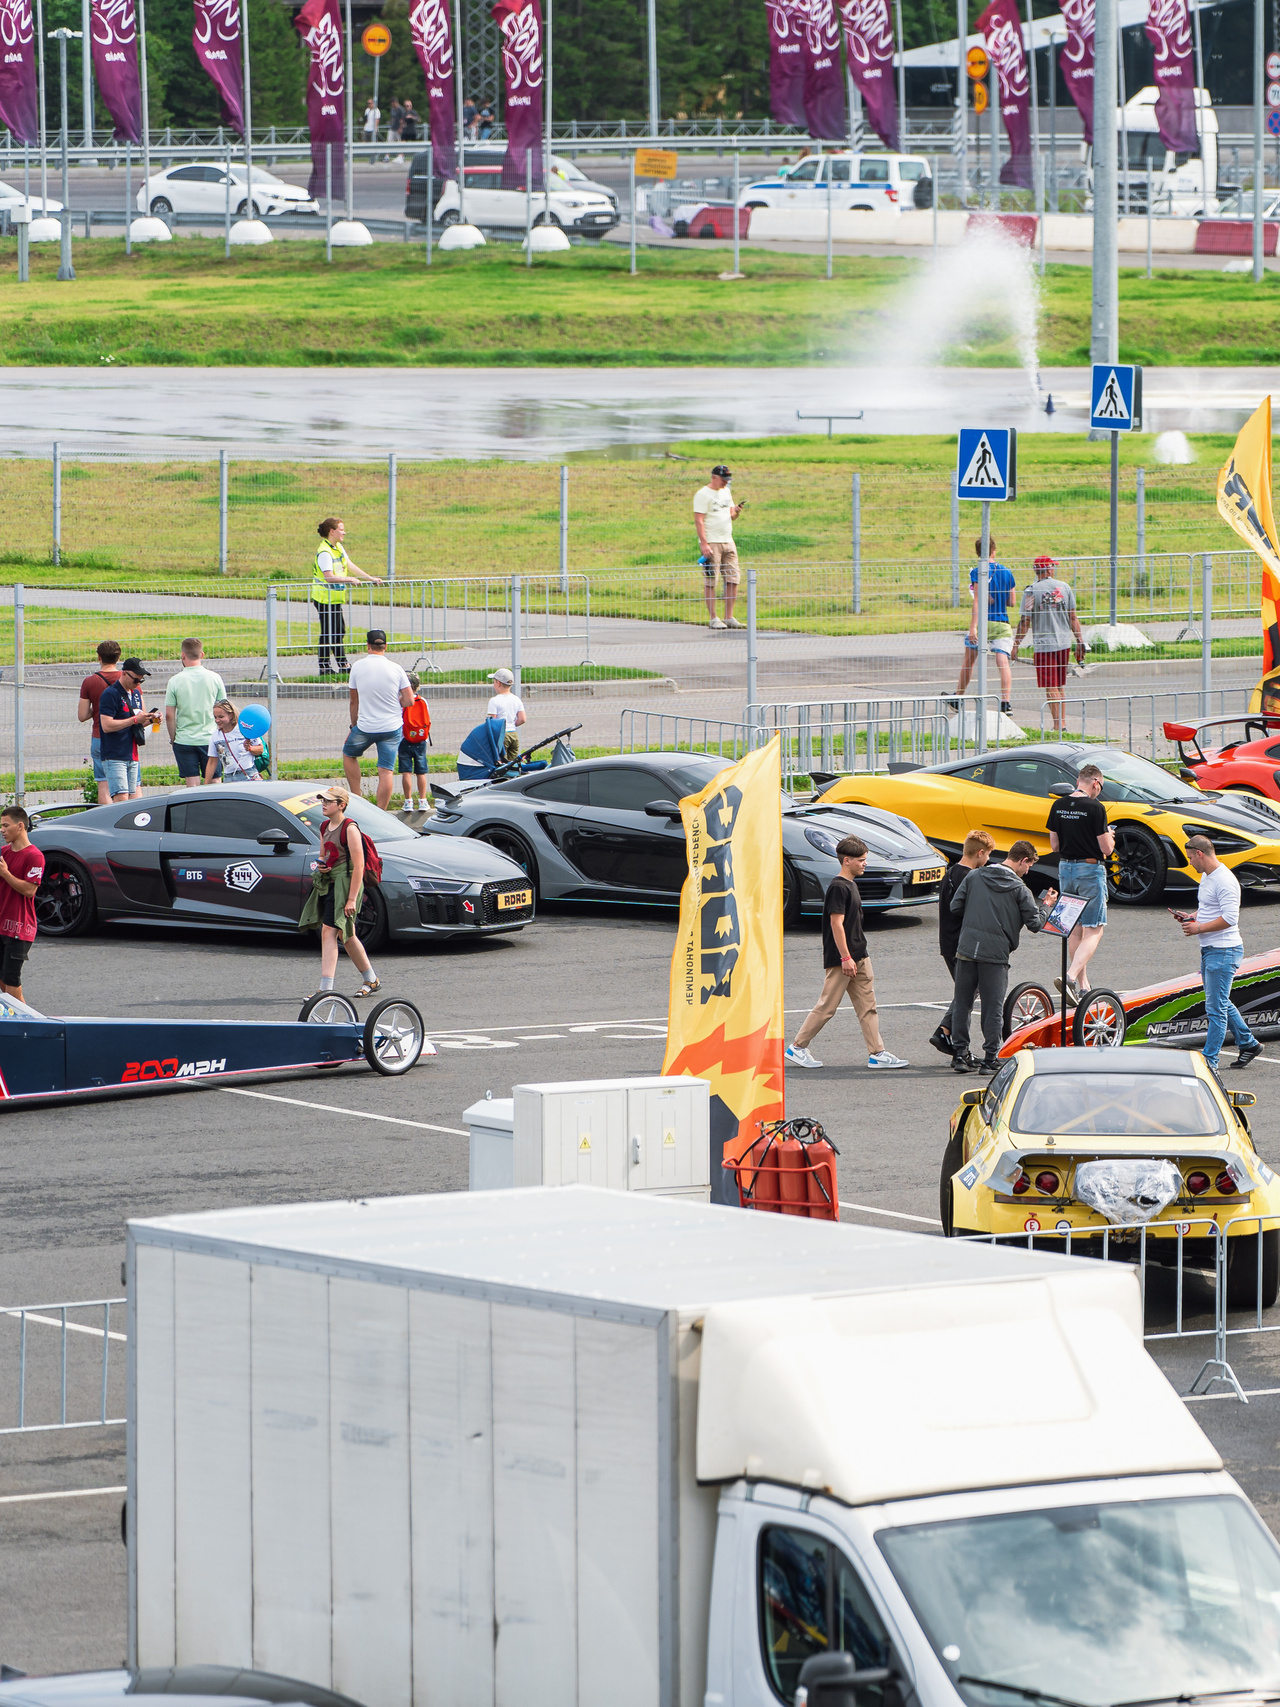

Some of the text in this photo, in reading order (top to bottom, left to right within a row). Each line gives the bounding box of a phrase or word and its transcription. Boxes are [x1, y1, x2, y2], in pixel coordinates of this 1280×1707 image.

[186, 869, 204, 881] ВТБ
[919, 868, 941, 882] RDRC
[504, 892, 527, 907] RDRC
[2, 918, 24, 934] JUST
[1146, 1019, 1188, 1036] NIGHT
